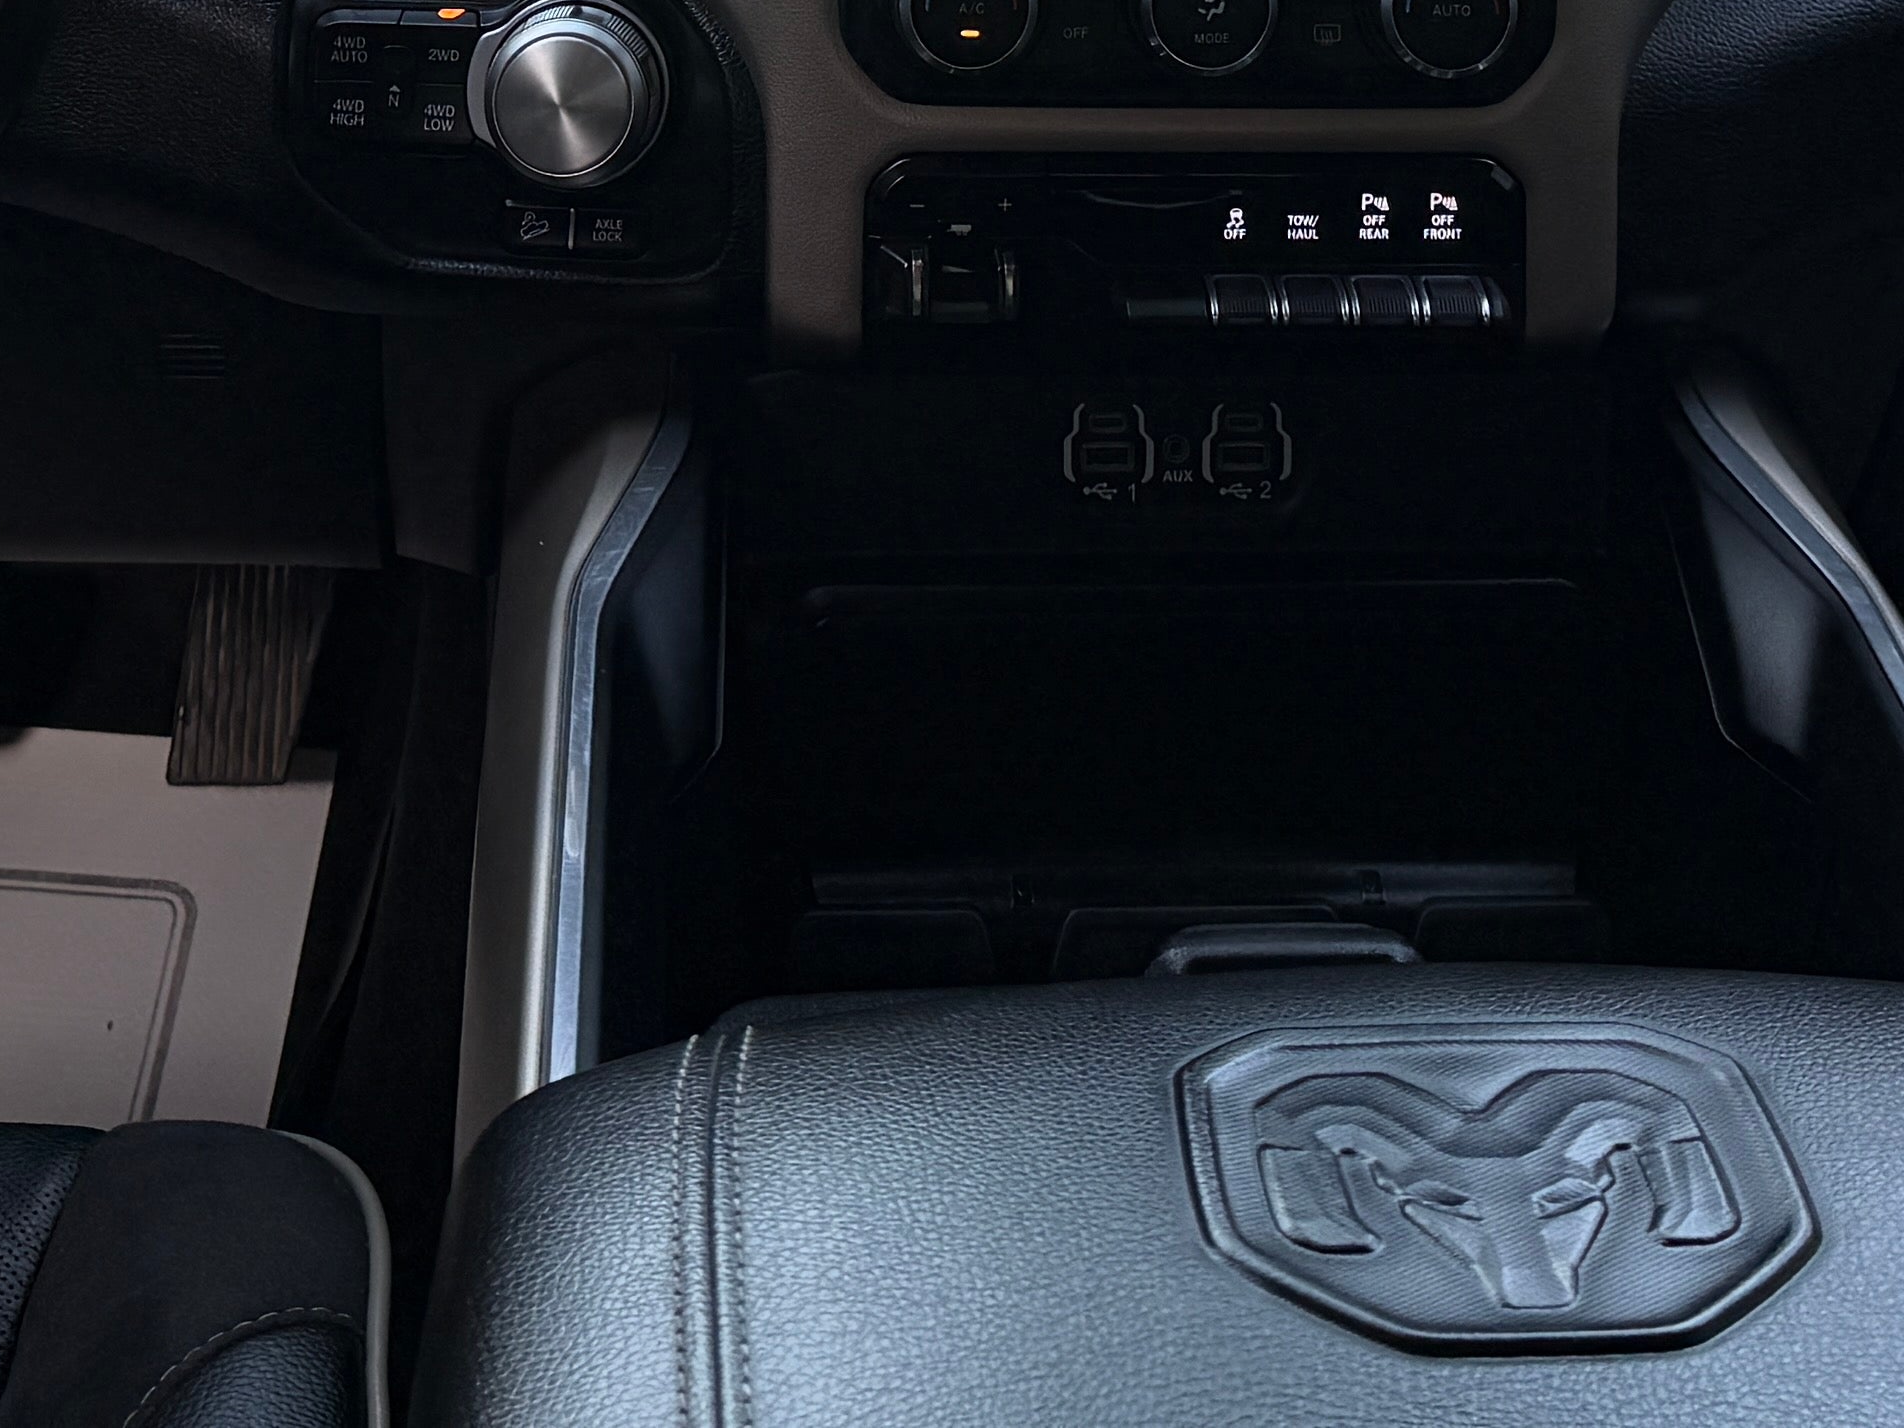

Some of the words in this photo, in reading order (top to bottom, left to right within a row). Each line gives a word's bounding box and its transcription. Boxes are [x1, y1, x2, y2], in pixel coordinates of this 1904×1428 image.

[959, 2, 985, 16] A/C
[1432, 4, 1472, 17] AUTO
[1062, 26, 1089, 40] OFF
[1194, 32, 1230, 44] MODE
[333, 36, 366, 49] 4WD
[330, 50, 368, 63] AUTO
[428, 49, 459, 61] 2WD
[332, 99, 365, 112] 4WD
[388, 94, 399, 107] N
[424, 104, 455, 118] 4WD
[329, 113, 365, 126] HIGH
[423, 118, 455, 131] LOW
[595, 218, 623, 230] AXLE
[1288, 215, 1319, 227] TOW/
[1363, 215, 1386, 226] OFF
[1431, 215, 1454, 226] OFF
[592, 230, 623, 241] LOCK
[1224, 229, 1246, 239] OFF
[1288, 228, 1319, 240] HAUL
[1359, 228, 1389, 240] REAR
[1423, 228, 1462, 240] FRONT
[1162, 470, 1193, 482] AUX
[1128, 483, 1135, 503] 1
[1259, 480, 1272, 499] 2
